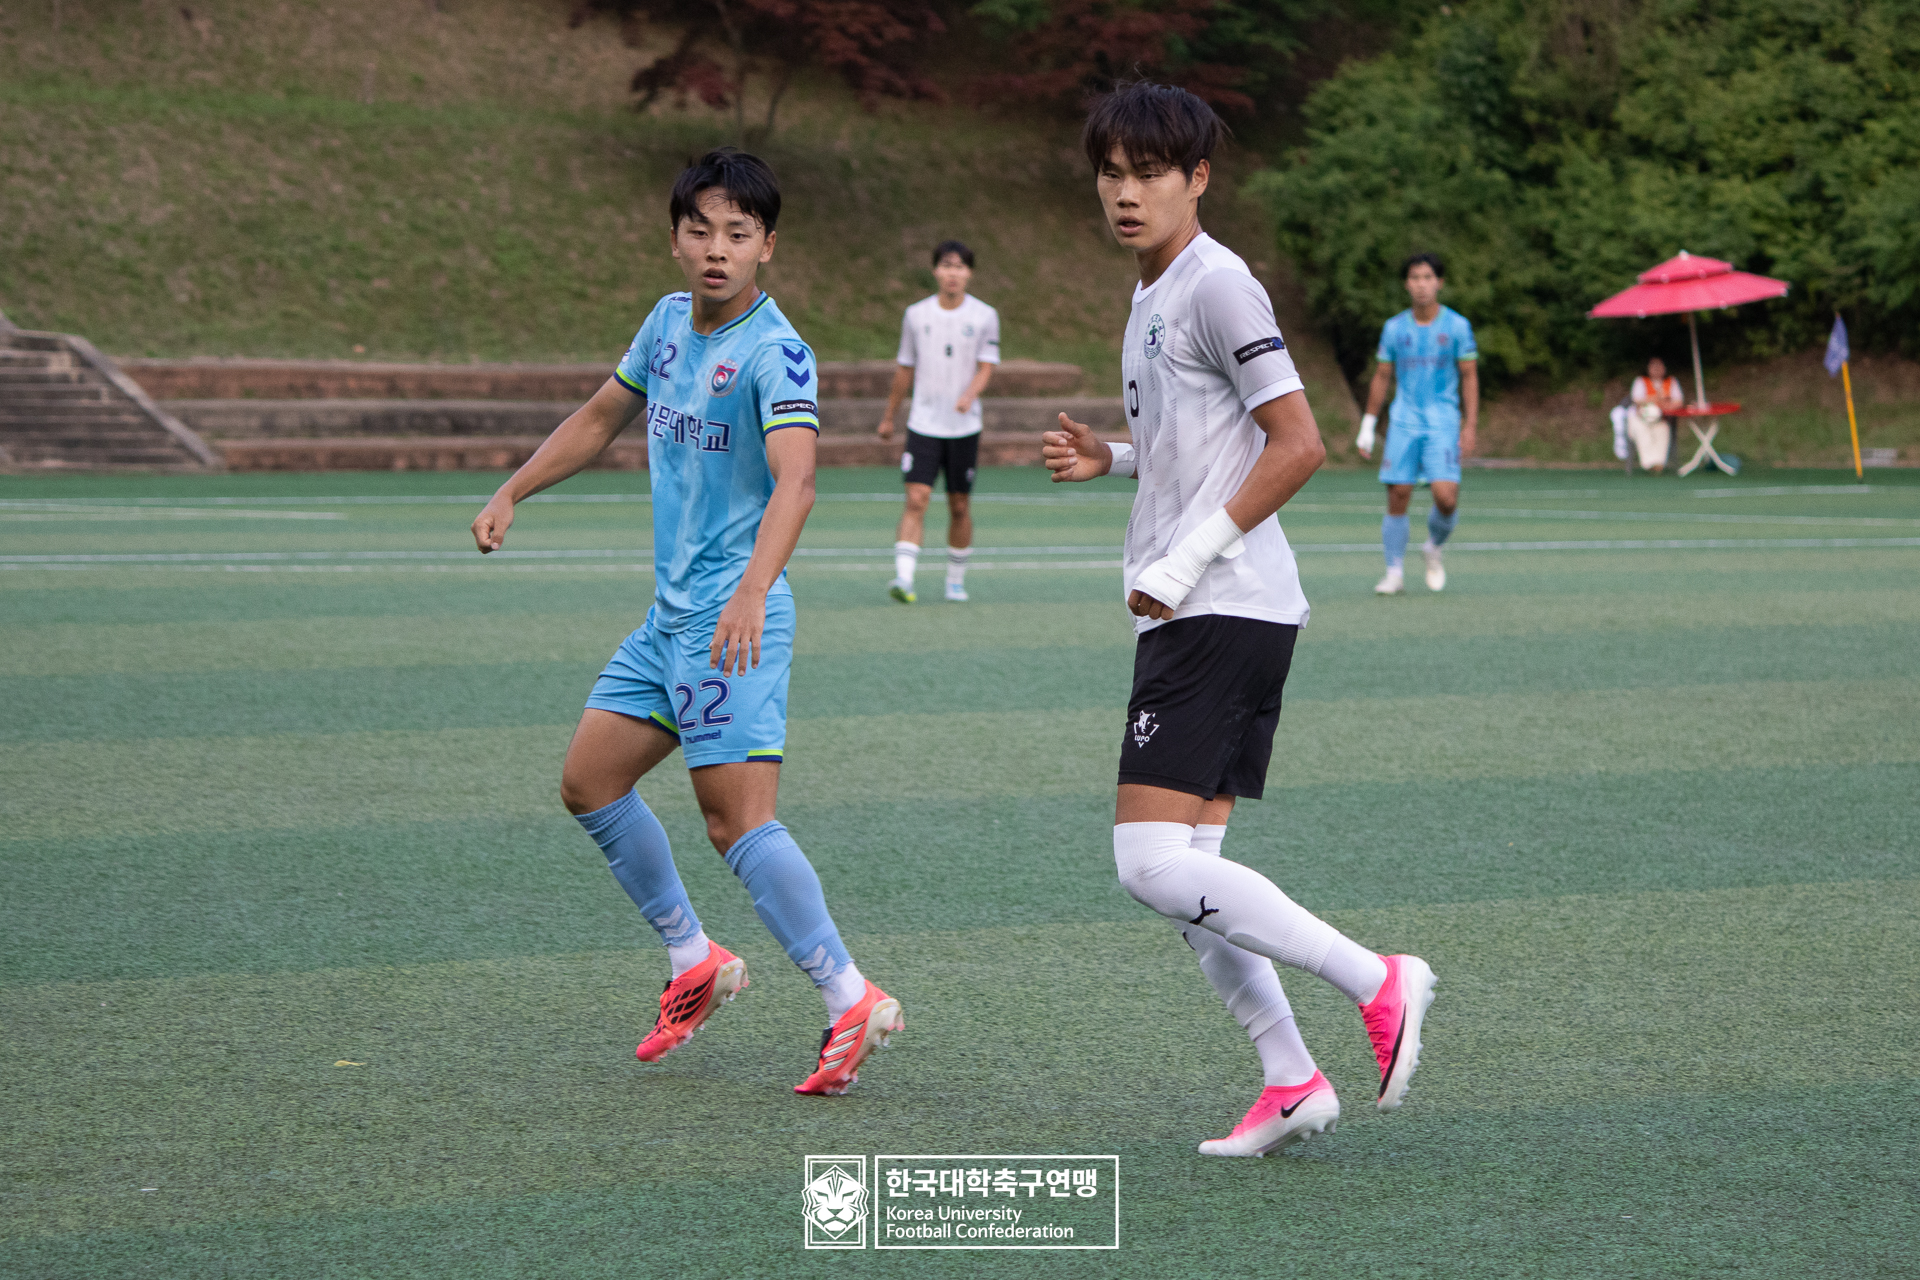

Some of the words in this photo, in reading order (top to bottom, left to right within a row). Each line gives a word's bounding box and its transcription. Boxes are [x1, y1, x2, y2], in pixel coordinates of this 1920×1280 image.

[1239, 341, 1274, 359] RESPECT
[773, 402, 815, 412] RESPECT
[675, 677, 733, 732] 22
[685, 729, 721, 744] hummel
